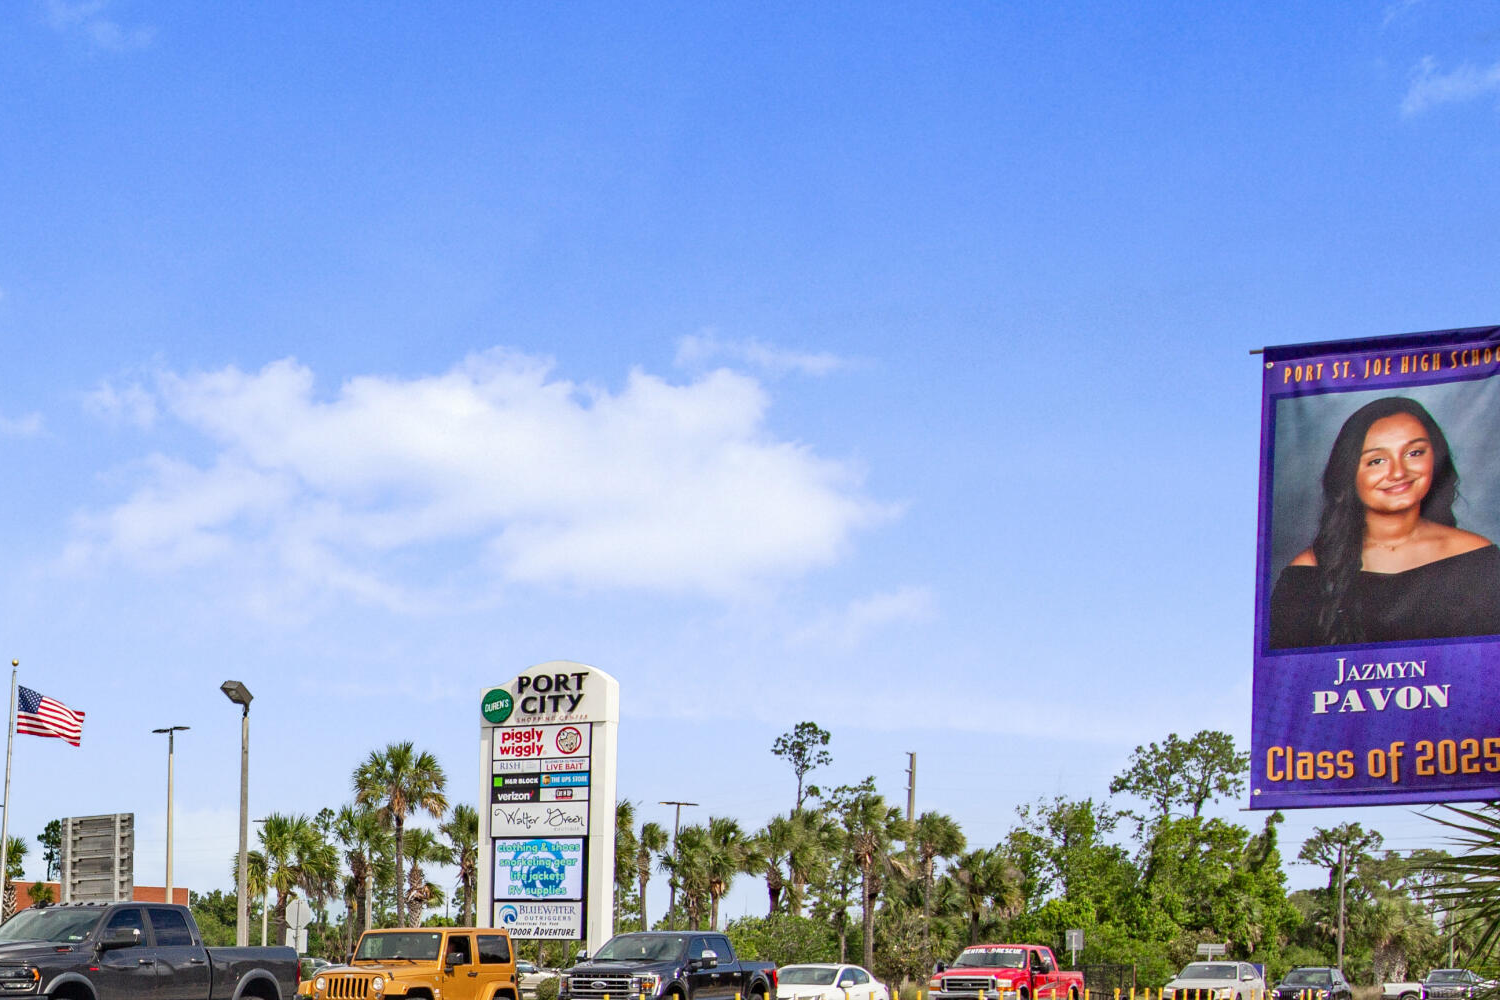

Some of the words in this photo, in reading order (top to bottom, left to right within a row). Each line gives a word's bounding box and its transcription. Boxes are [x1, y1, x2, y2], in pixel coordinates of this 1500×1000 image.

[1284, 363, 1324, 384] PORT
[1332, 361, 1356, 379] ST.
[1364, 357, 1391, 378] JOE
[1401, 352, 1441, 374] HIGH
[1451, 346, 1500, 369] SCHOO
[1334, 658, 1427, 686] JAZMYN
[517, 672, 590, 694] PORT
[484, 699, 509, 713] DUREN'S
[520, 694, 584, 714] CITY
[1312, 684, 1451, 714] PAVON
[502, 727, 543, 744] piggly
[500, 742, 543, 757] wiggly
[1266, 745, 1354, 782] Class
[1367, 741, 1405, 783] of
[1415, 737, 1500, 776] 2025
[497, 792, 530, 801] verizon
[494, 808, 540, 829] Walter
[497, 842, 538, 853] clothing
[540, 842, 548, 852] &
[551, 842, 580, 851] shoes
[499, 857, 552, 868] snorkeling
[554, 858, 578, 868] gear
[510, 872, 527, 880] life
[528, 871, 565, 882] jackets
[508, 885, 523, 895] RV
[525, 885, 567, 896] supplies
[519, 905, 576, 915] BLUEWATER
[501, 927, 532, 936] TDOOR
[533, 927, 576, 936] ADVENTURE
